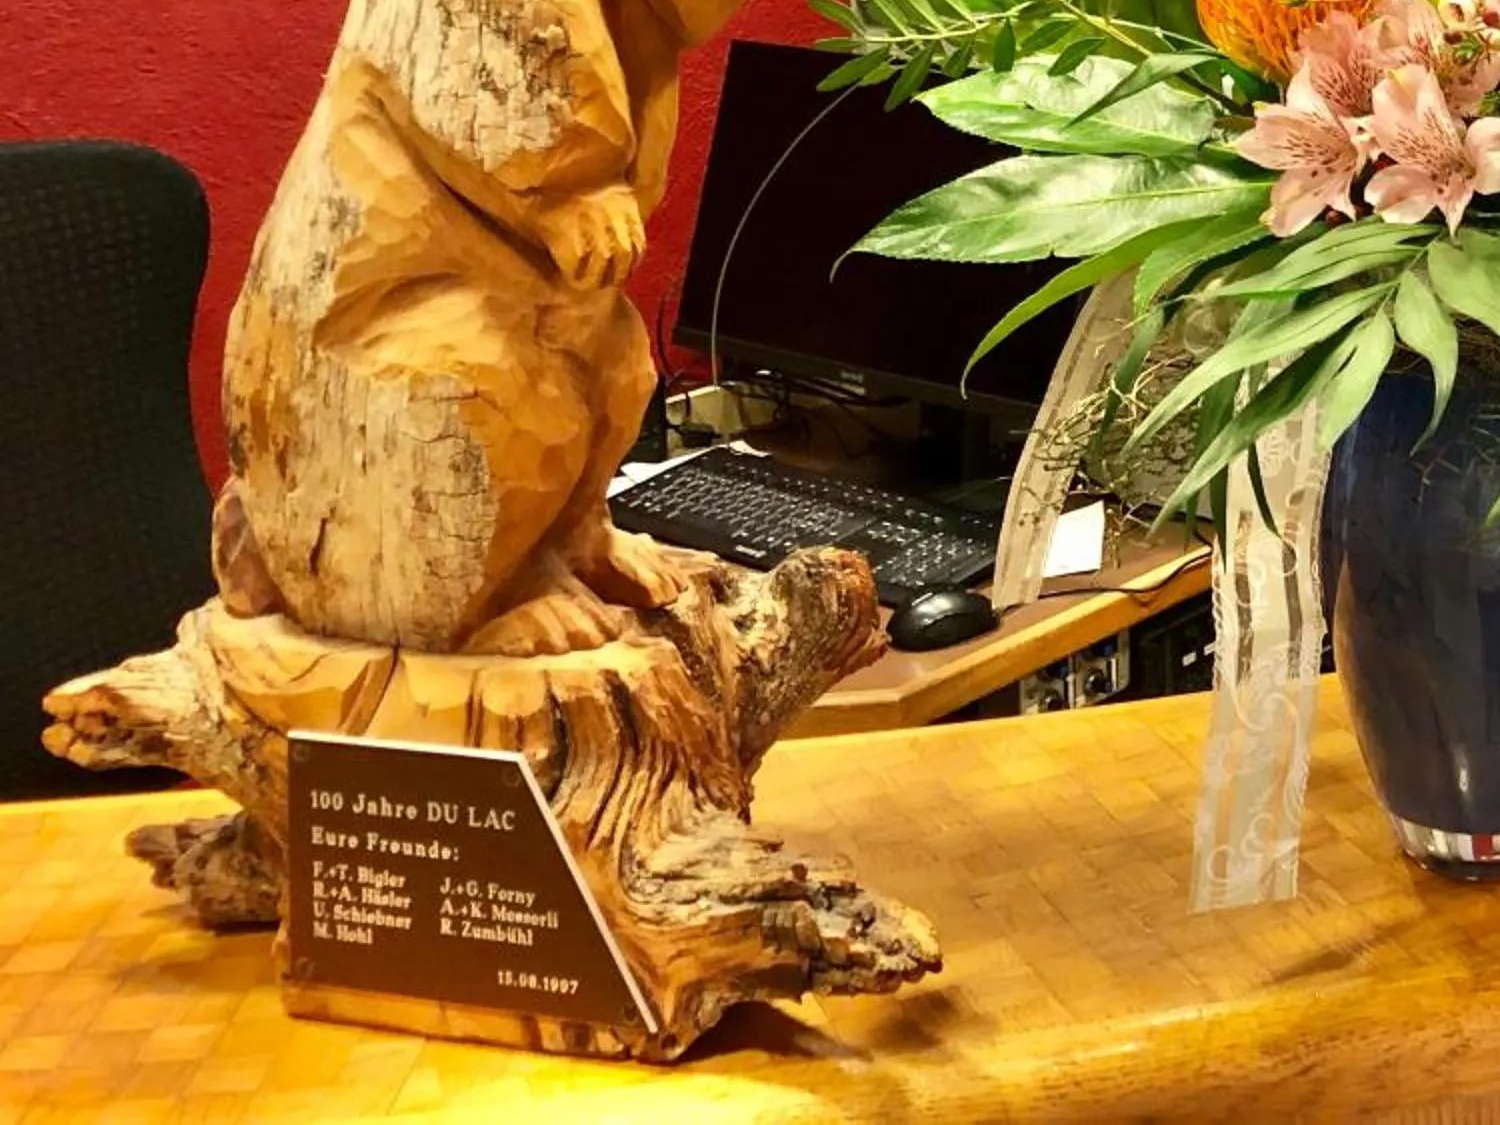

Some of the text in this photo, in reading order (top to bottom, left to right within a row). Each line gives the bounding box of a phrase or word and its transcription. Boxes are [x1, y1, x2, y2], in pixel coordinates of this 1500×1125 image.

[310, 789, 517, 831] 100 Jahre DU LAC
[311, 826, 461, 862] Eure Freunde:
[487, 882, 537, 908] Forny
[461, 920, 534, 948] Zumbühl
